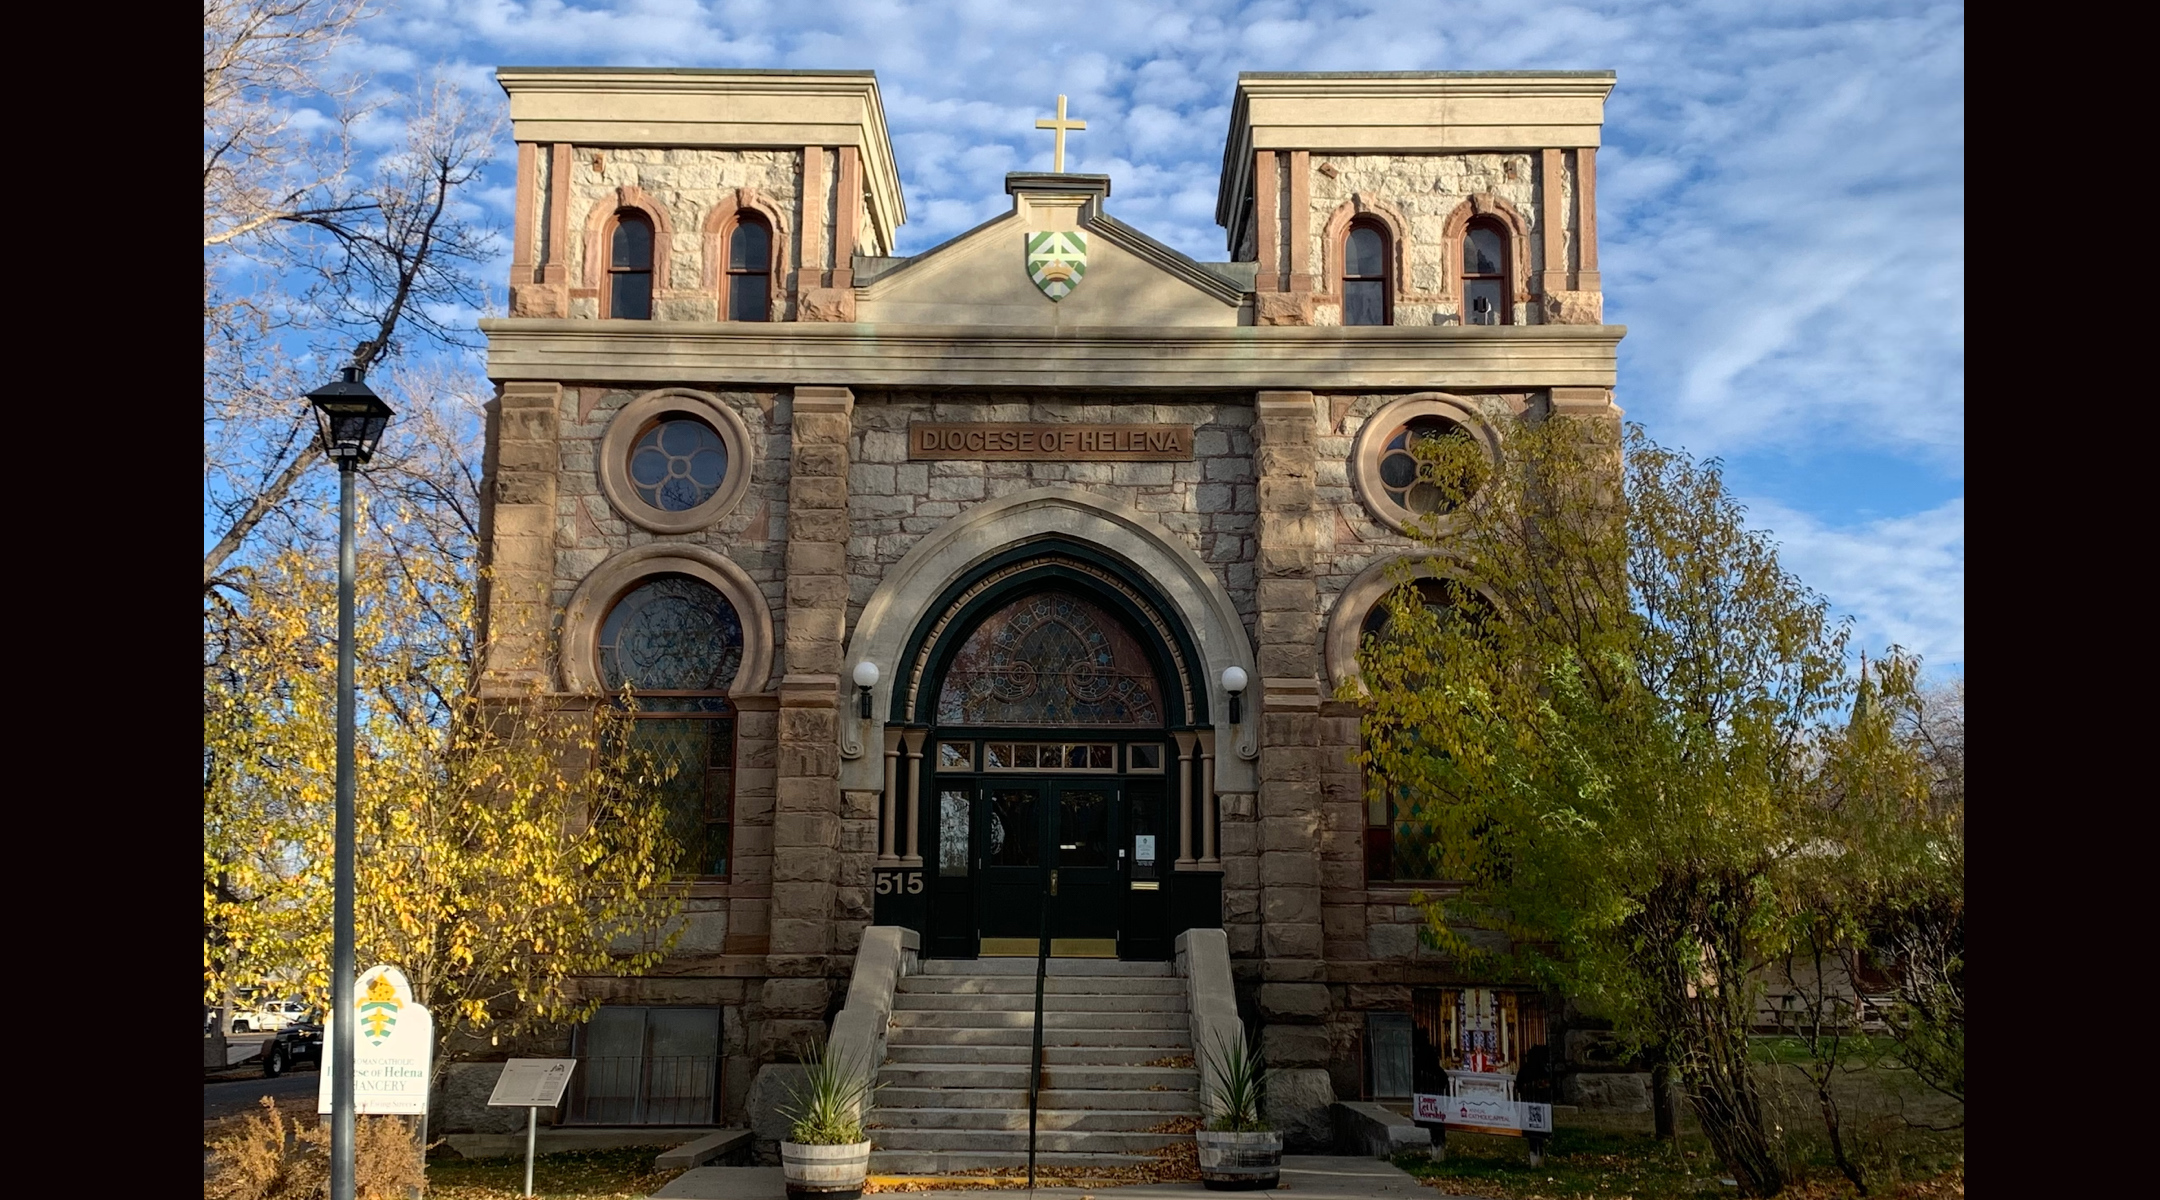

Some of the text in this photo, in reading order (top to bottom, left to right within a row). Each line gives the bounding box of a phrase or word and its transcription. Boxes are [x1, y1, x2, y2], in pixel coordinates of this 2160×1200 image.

[921, 429, 1183, 453] DIOCESE OF HELENA
[875, 872, 924, 895] 515
[378, 1058, 414, 1066] CATHOLIC
[384, 1066, 423, 1078] Helena
